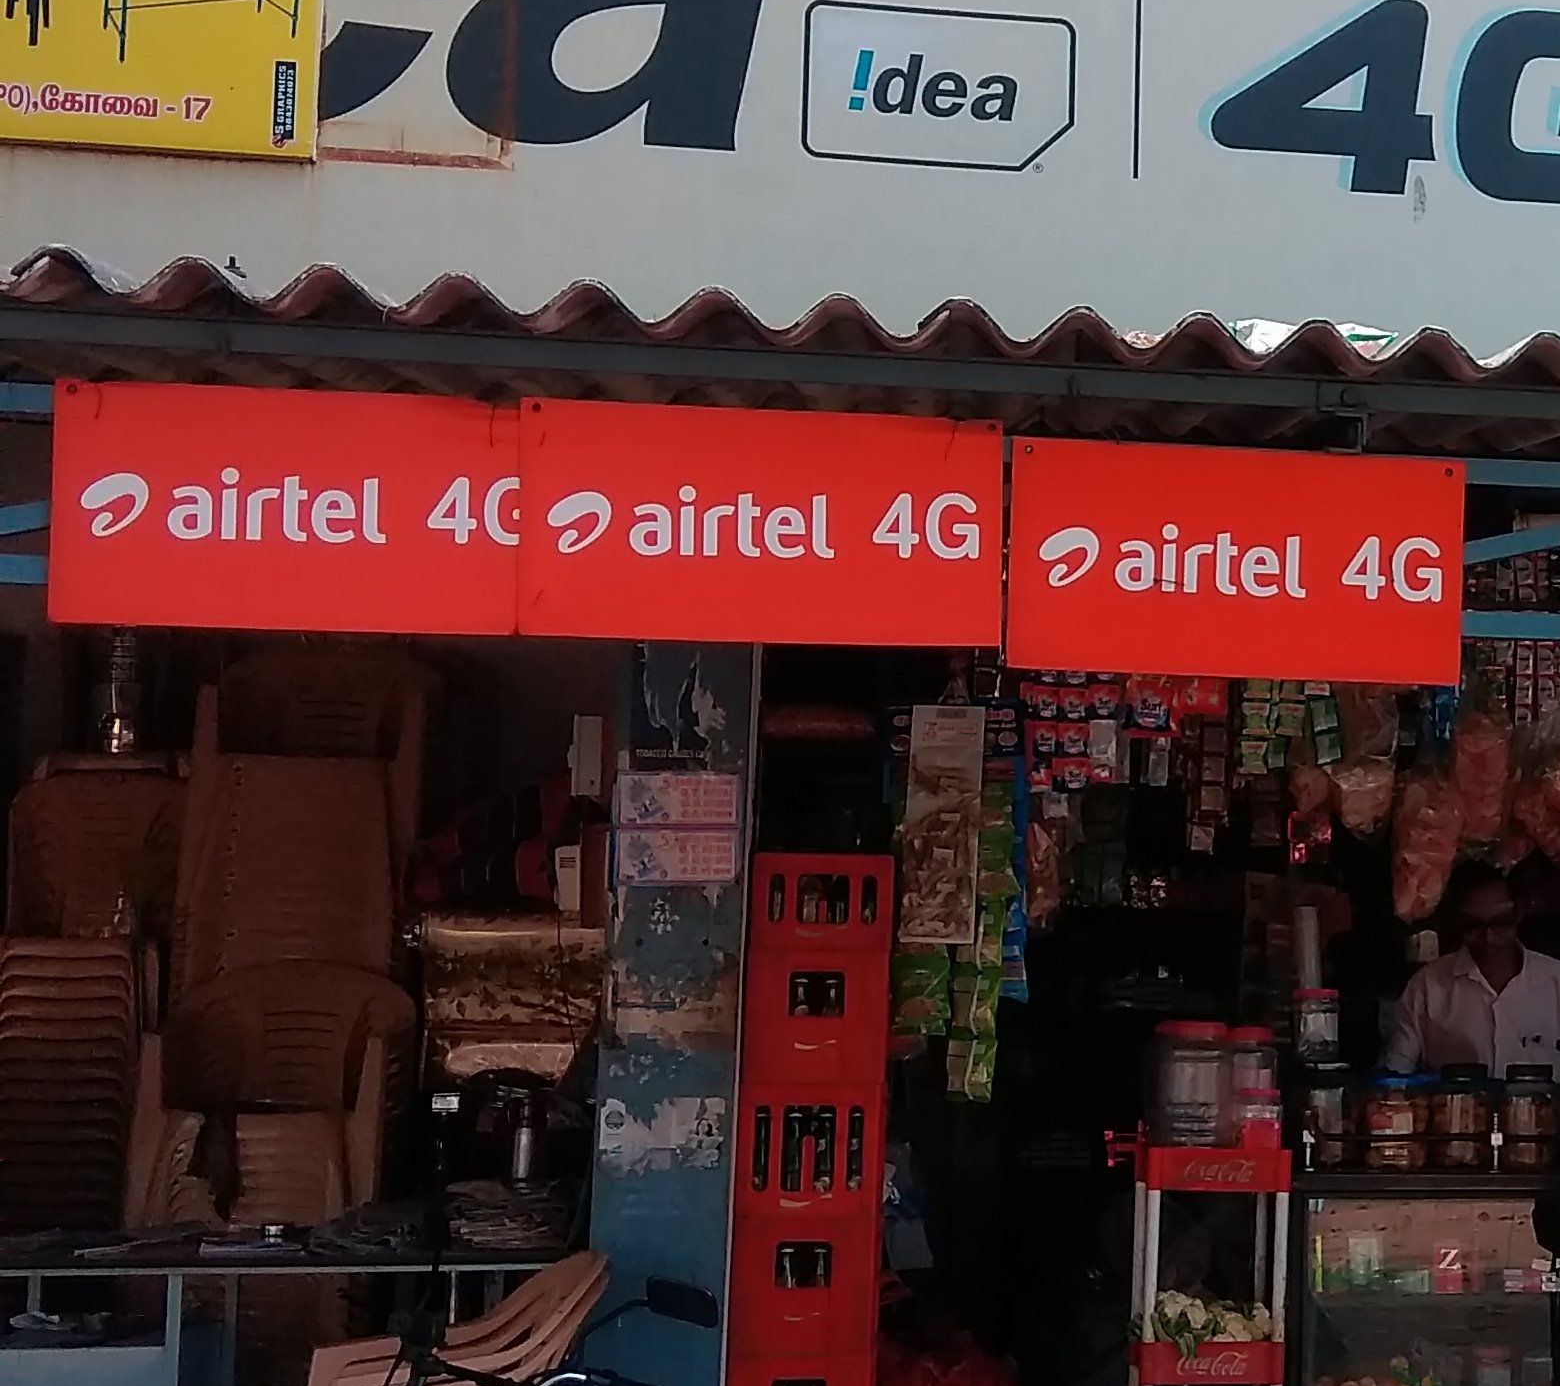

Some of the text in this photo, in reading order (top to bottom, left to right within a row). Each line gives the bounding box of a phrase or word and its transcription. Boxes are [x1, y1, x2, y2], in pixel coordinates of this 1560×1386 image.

[183, 97, 211, 121] 17
[277, 65, 286, 123] GRAPHICS
[167, 467, 386, 544] airtel
[628, 485, 981, 560] airtel 4G
[1114, 524, 1443, 603] airtel 4G
